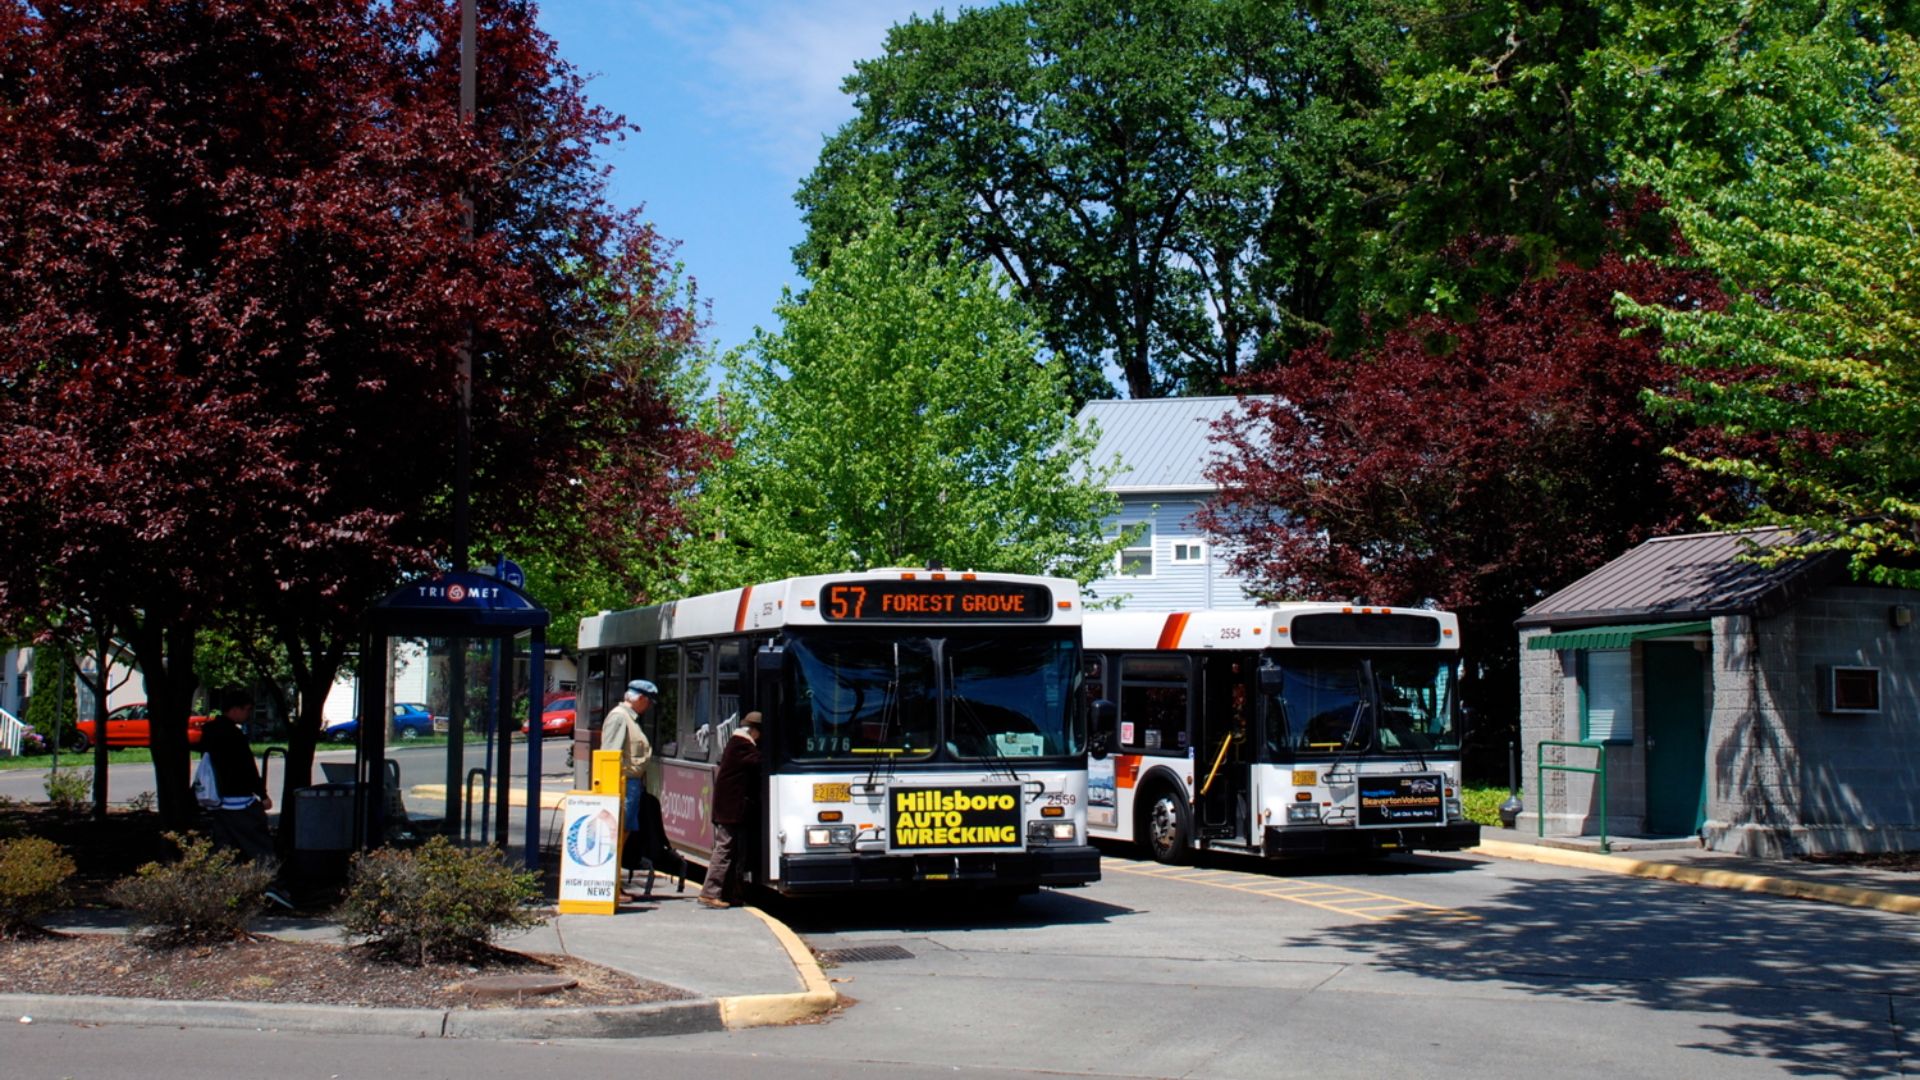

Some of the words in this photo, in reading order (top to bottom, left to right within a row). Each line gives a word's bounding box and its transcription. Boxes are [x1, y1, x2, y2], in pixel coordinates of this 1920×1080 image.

[419, 586, 444, 597] TRI
[467, 587, 499, 598] MET
[830, 586, 867, 619] 57
[881, 593, 954, 612] FOREST
[961, 594, 1025, 612] GROVE
[1220, 627, 1241, 639] 2554
[807, 737, 851, 752] 5776
[896, 790, 1016, 812] Hillsboro
[1047, 794, 1077, 806] 2559
[1361, 796, 1440, 807] BeavertonVolvo.com
[896, 811, 963, 829] AUTO
[896, 826, 1016, 845] WRECKING
[565, 878, 582, 887] HIGH
[583, 879, 615, 888] DEFINITION
[587, 887, 612, 897] NEWS
